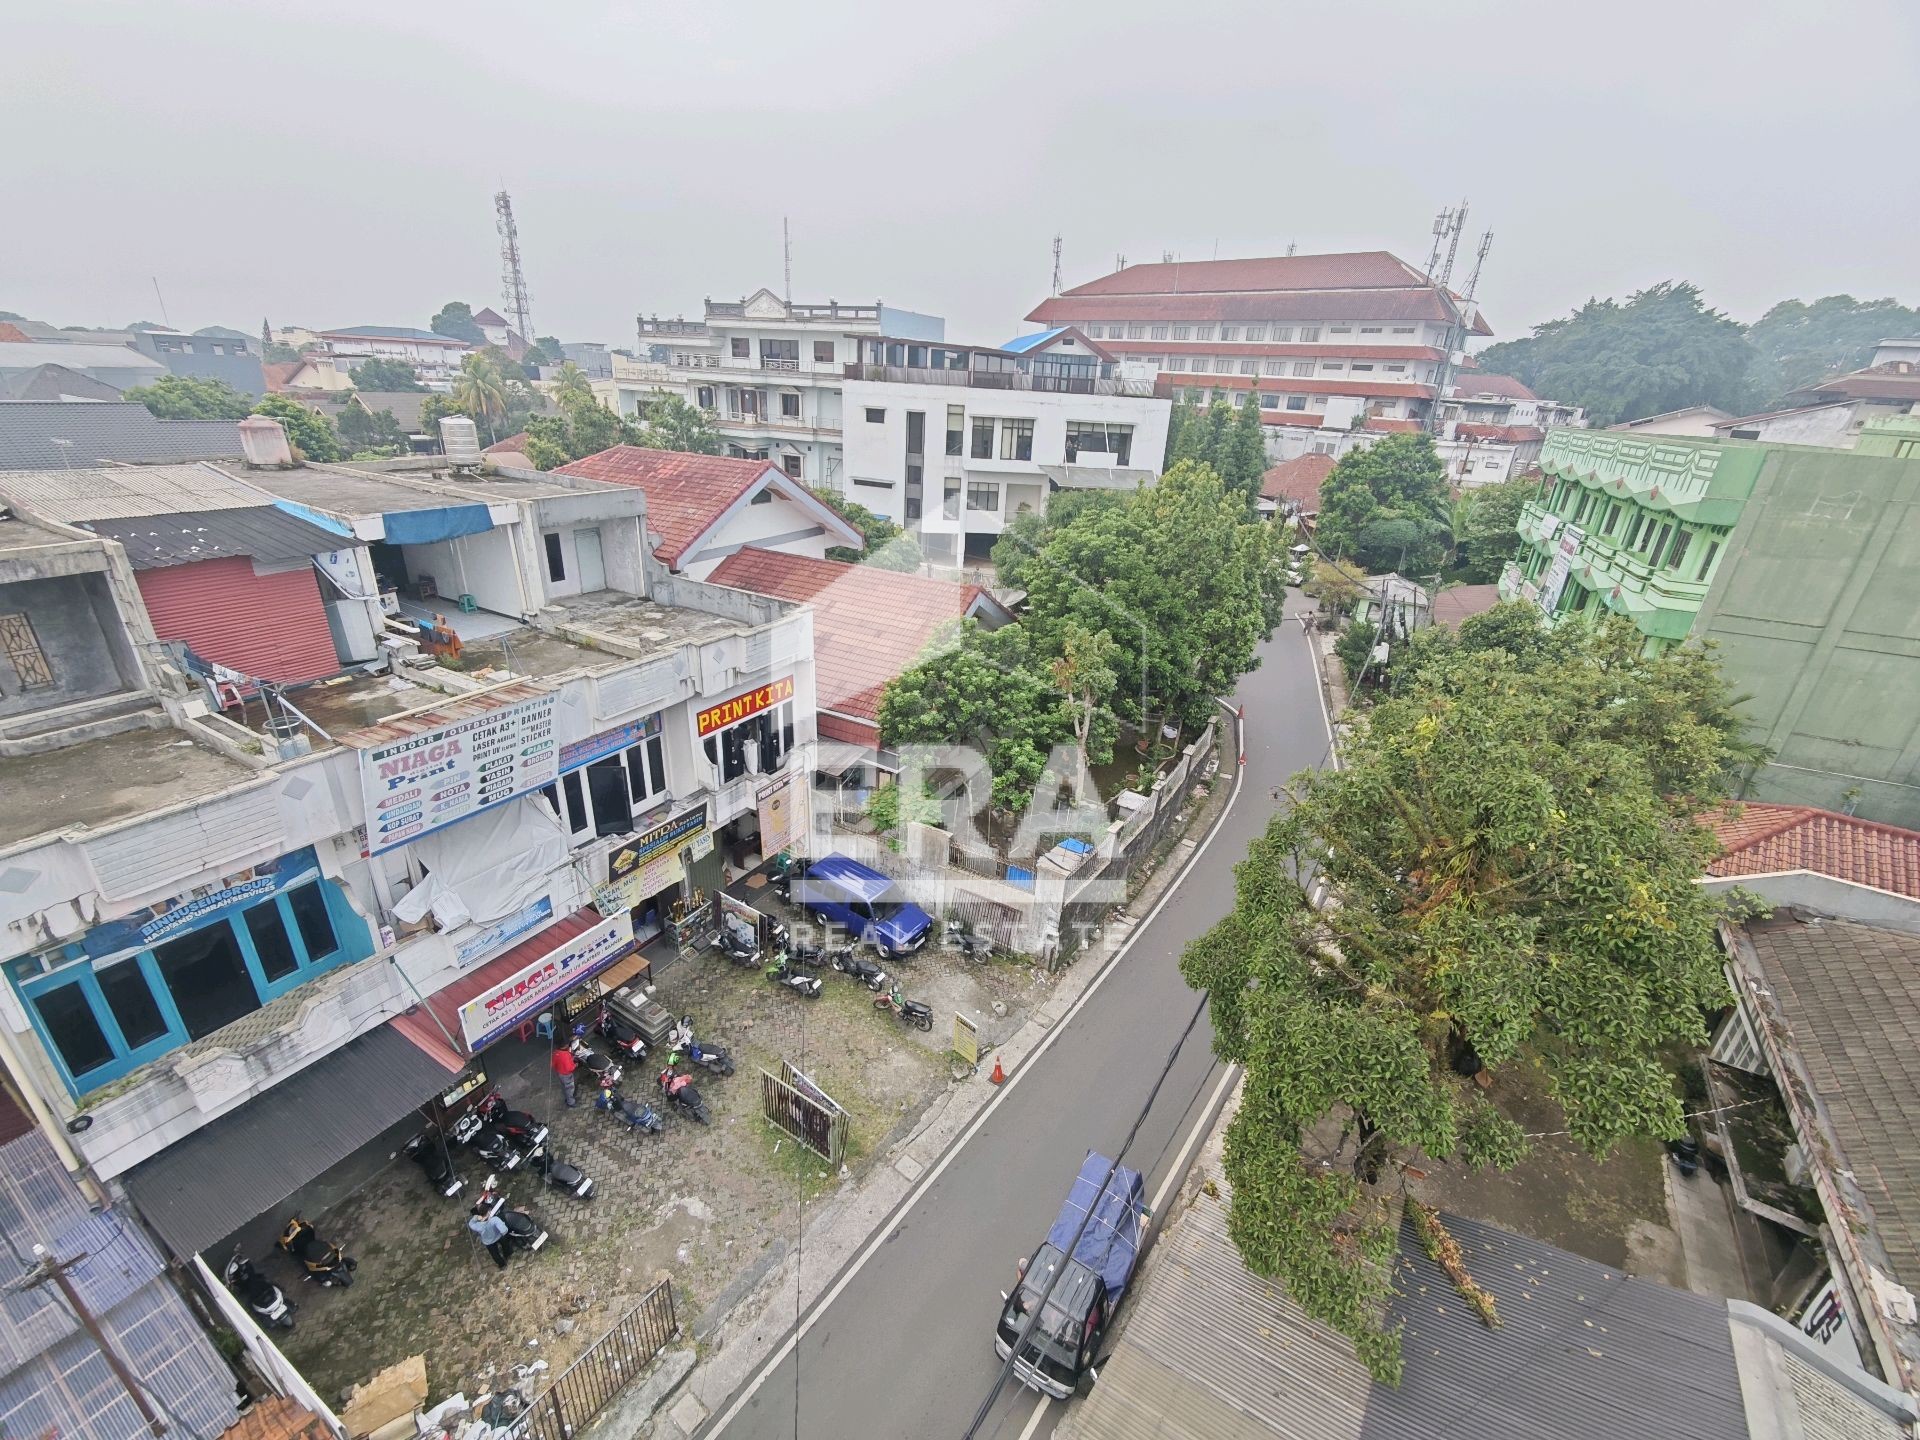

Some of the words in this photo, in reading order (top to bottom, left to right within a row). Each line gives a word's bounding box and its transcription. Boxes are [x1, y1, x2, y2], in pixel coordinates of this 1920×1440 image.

[698, 695, 752, 733] PRINT
[755, 679, 793, 709] KITA
[521, 707, 552, 726] BANNER
[383, 736, 434, 758] INDOOR
[449, 714, 503, 736] OUTDOOR
[472, 726, 498, 742] CETAK
[520, 727, 552, 745] STICKER
[472, 738, 496, 753] LASER
[472, 749, 491, 762] PRINT
[492, 746, 501, 756] UV
[527, 740, 553, 756] PIALA
[378, 739, 462, 780] NIAGA
[485, 755, 512, 771] PLAKAT
[387, 759, 456, 791] Print
[443, 773, 461, 786] PIN
[485, 766, 511, 782] YASIN
[440, 784, 466, 799] NOTA
[485, 777, 512, 793] PIAGAM
[385, 789, 418, 807] MEDALI
[488, 788, 511, 802] MUG
[386, 801, 421, 819] UNDANGAN
[387, 821, 400, 831] KOP
[400, 812, 421, 827] SURAT
[669, 825, 686, 839] BUKU
[686, 815, 703, 829] YASIN
[640, 820, 677, 848] MITRA
[623, 874, 638, 888] MUG
[170, 914, 193, 930] AND
[194, 898, 231, 917] UMRAH
[230, 884, 276, 903] SERVICES
[485, 962, 558, 1017] NIAGA
[560, 928, 617, 971] Print
[482, 1015, 500, 1029] CETAK
[517, 994, 534, 1007] LASER
[558, 969, 573, 980] PRINT
[604, 936, 623, 951] BANNER
